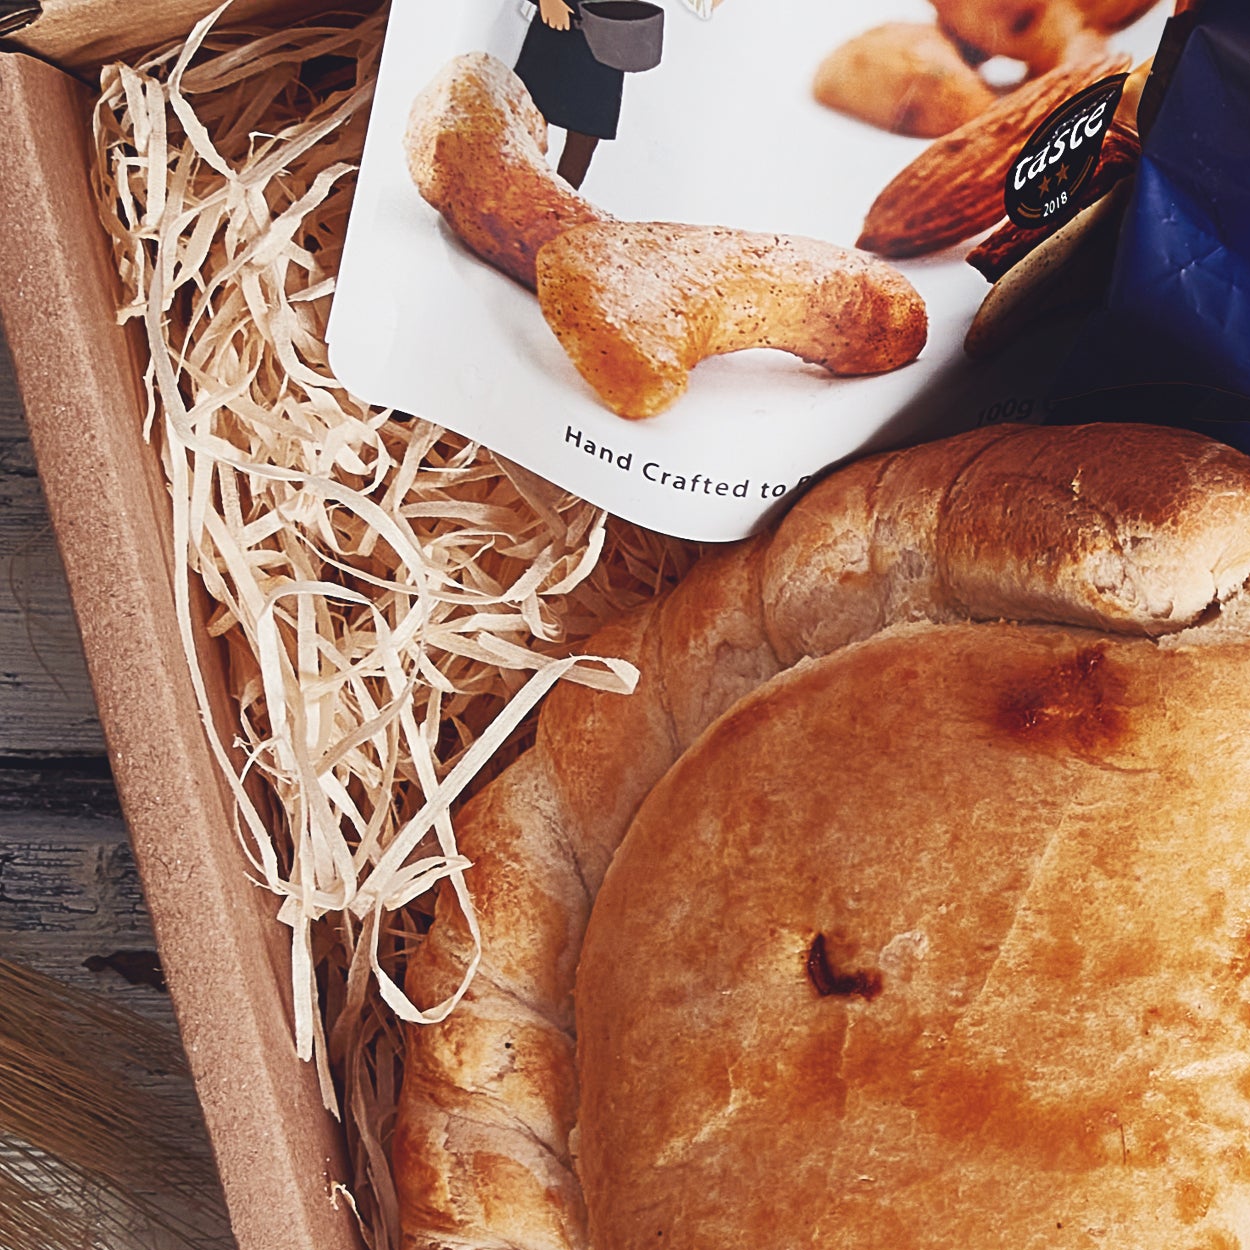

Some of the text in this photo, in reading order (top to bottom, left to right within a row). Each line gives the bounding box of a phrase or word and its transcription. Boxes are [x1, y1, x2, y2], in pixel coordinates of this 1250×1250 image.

[1043, 191, 1068, 217] 2018
[564, 425, 787, 498] Hand Crafted to
